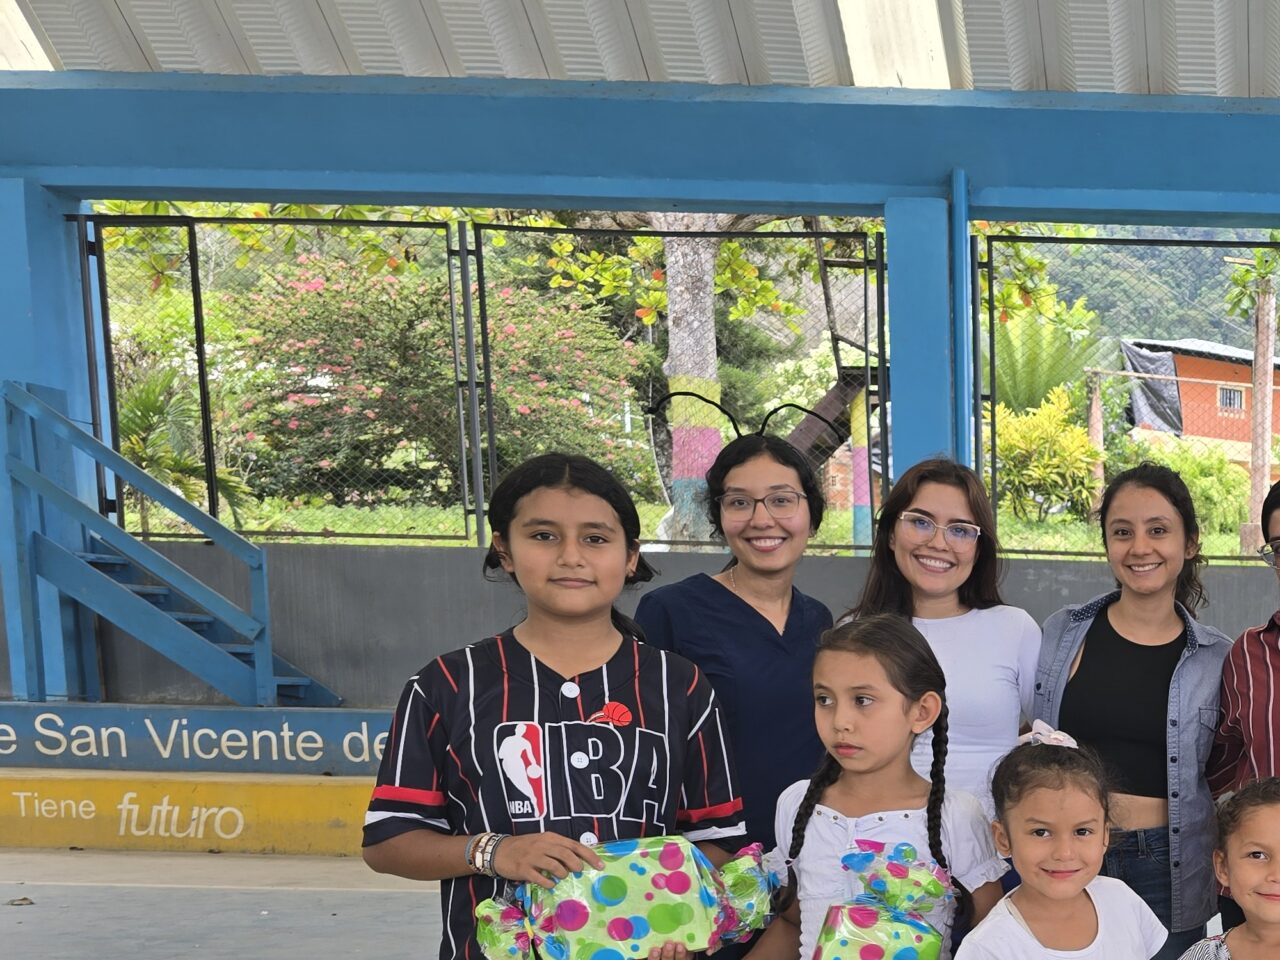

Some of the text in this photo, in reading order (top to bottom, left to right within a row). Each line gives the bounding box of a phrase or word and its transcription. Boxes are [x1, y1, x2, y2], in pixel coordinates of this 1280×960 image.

[34, 713, 127, 757] San
[144, 718, 325, 762] Vicente
[12, 791, 245, 840] Tiene futuro
[508, 800, 533, 814] NBA
